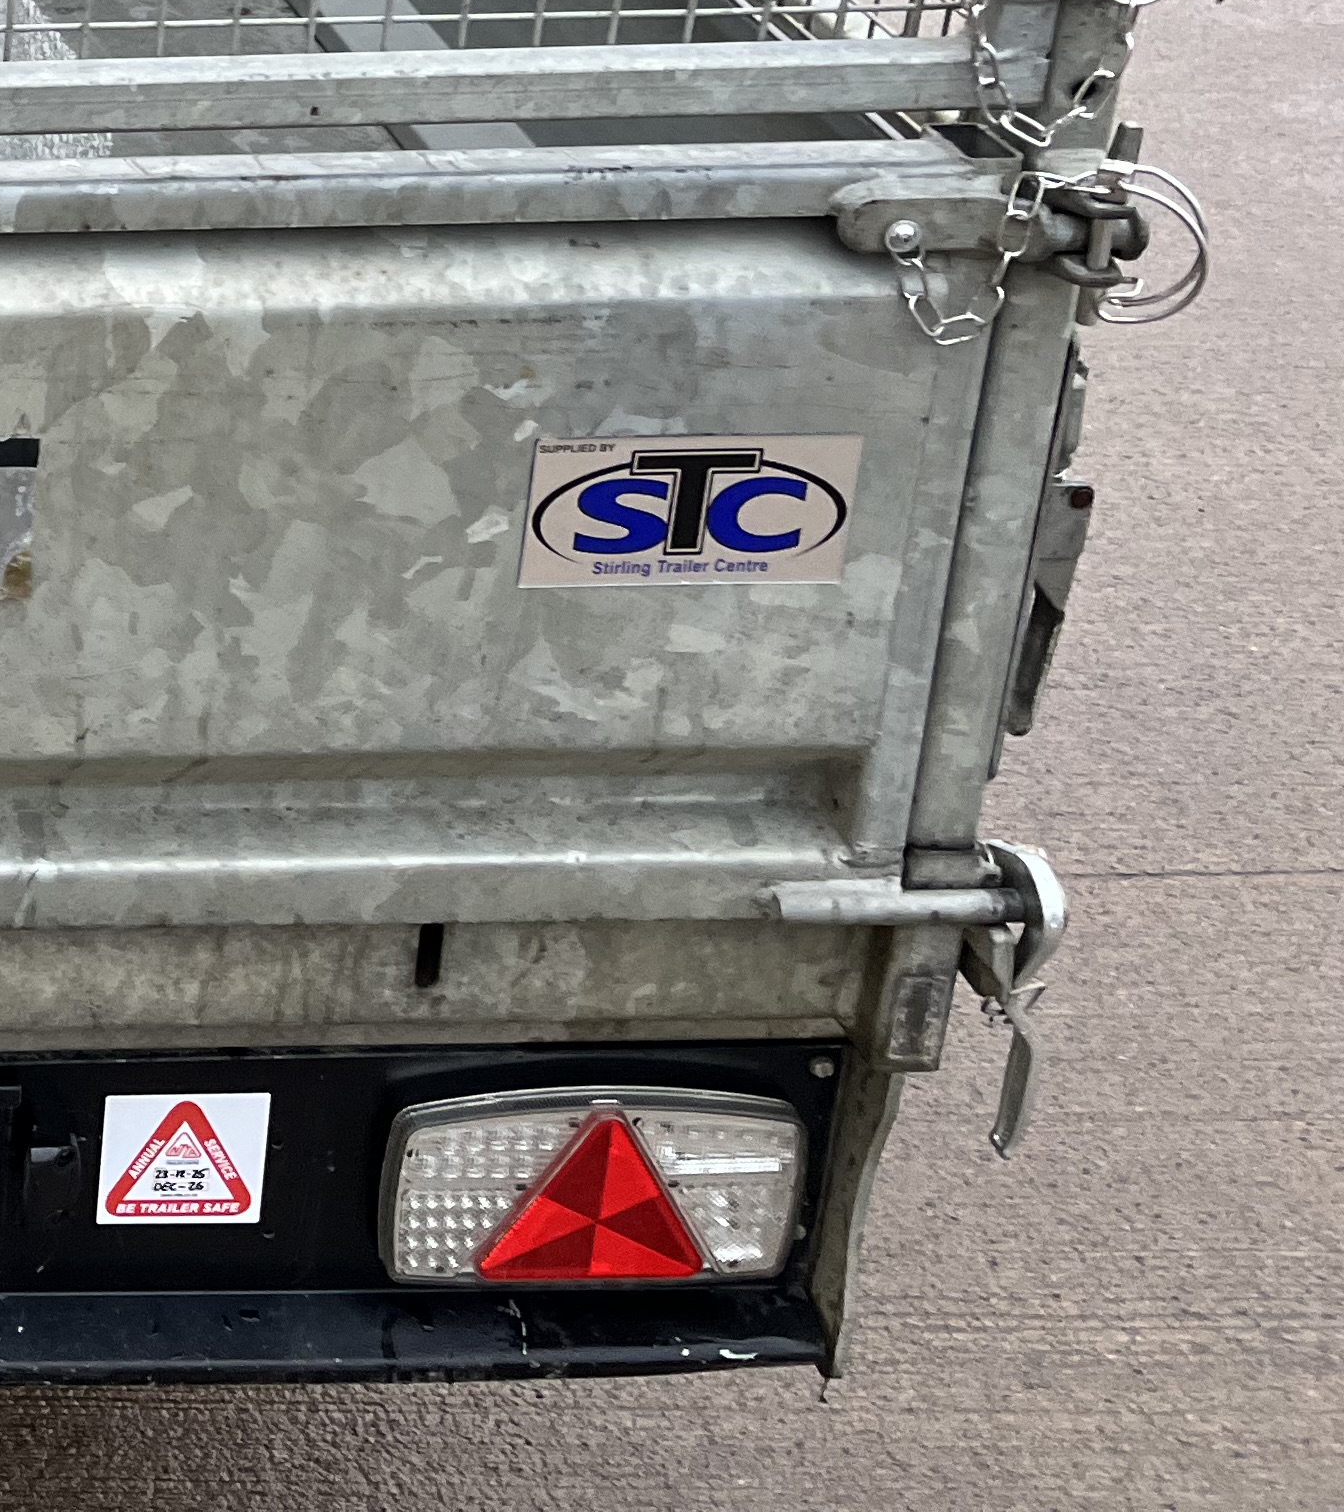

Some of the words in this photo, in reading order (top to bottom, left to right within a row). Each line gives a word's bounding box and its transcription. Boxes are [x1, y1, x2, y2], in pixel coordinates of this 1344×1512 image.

[538, 444, 597, 454] SUPPLIED
[599, 443, 616, 453] BY
[572, 448, 808, 555] STC
[592, 560, 652, 577] Stirling
[657, 559, 710, 574] Trailer
[714, 558, 769, 573] Centre
[128, 1138, 165, 1180] ANNUAL
[203, 1138, 238, 1180] SERVICE
[115, 1203, 135, 1214] BE
[139, 1202, 199, 1214] TRAILER
[203, 1201, 241, 1213] SAFE
